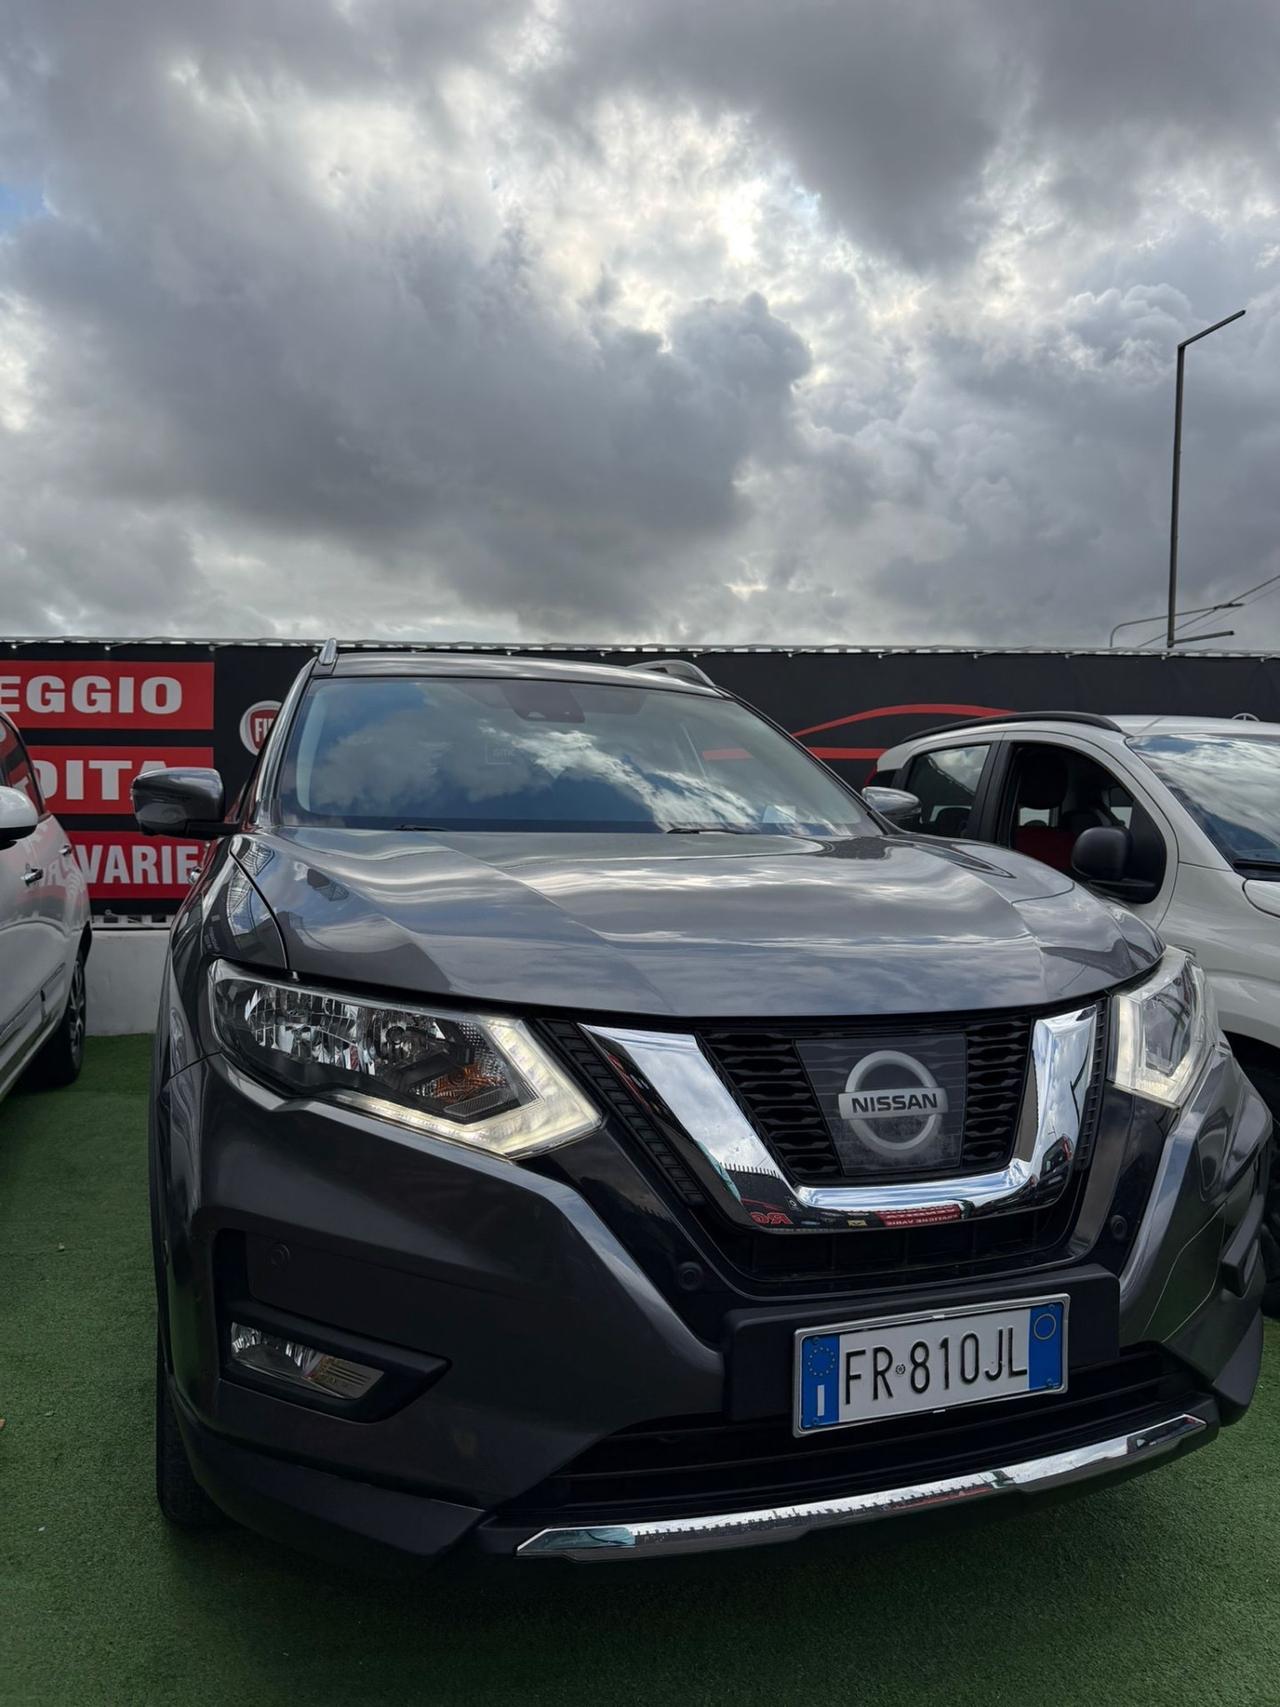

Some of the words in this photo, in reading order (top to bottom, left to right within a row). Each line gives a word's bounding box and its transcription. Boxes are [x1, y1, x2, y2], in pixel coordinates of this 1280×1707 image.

[0, 675, 182, 714] EGGIO
[75, 844, 199, 885] VARIE
[851, 1092, 939, 1114] NISSAN
